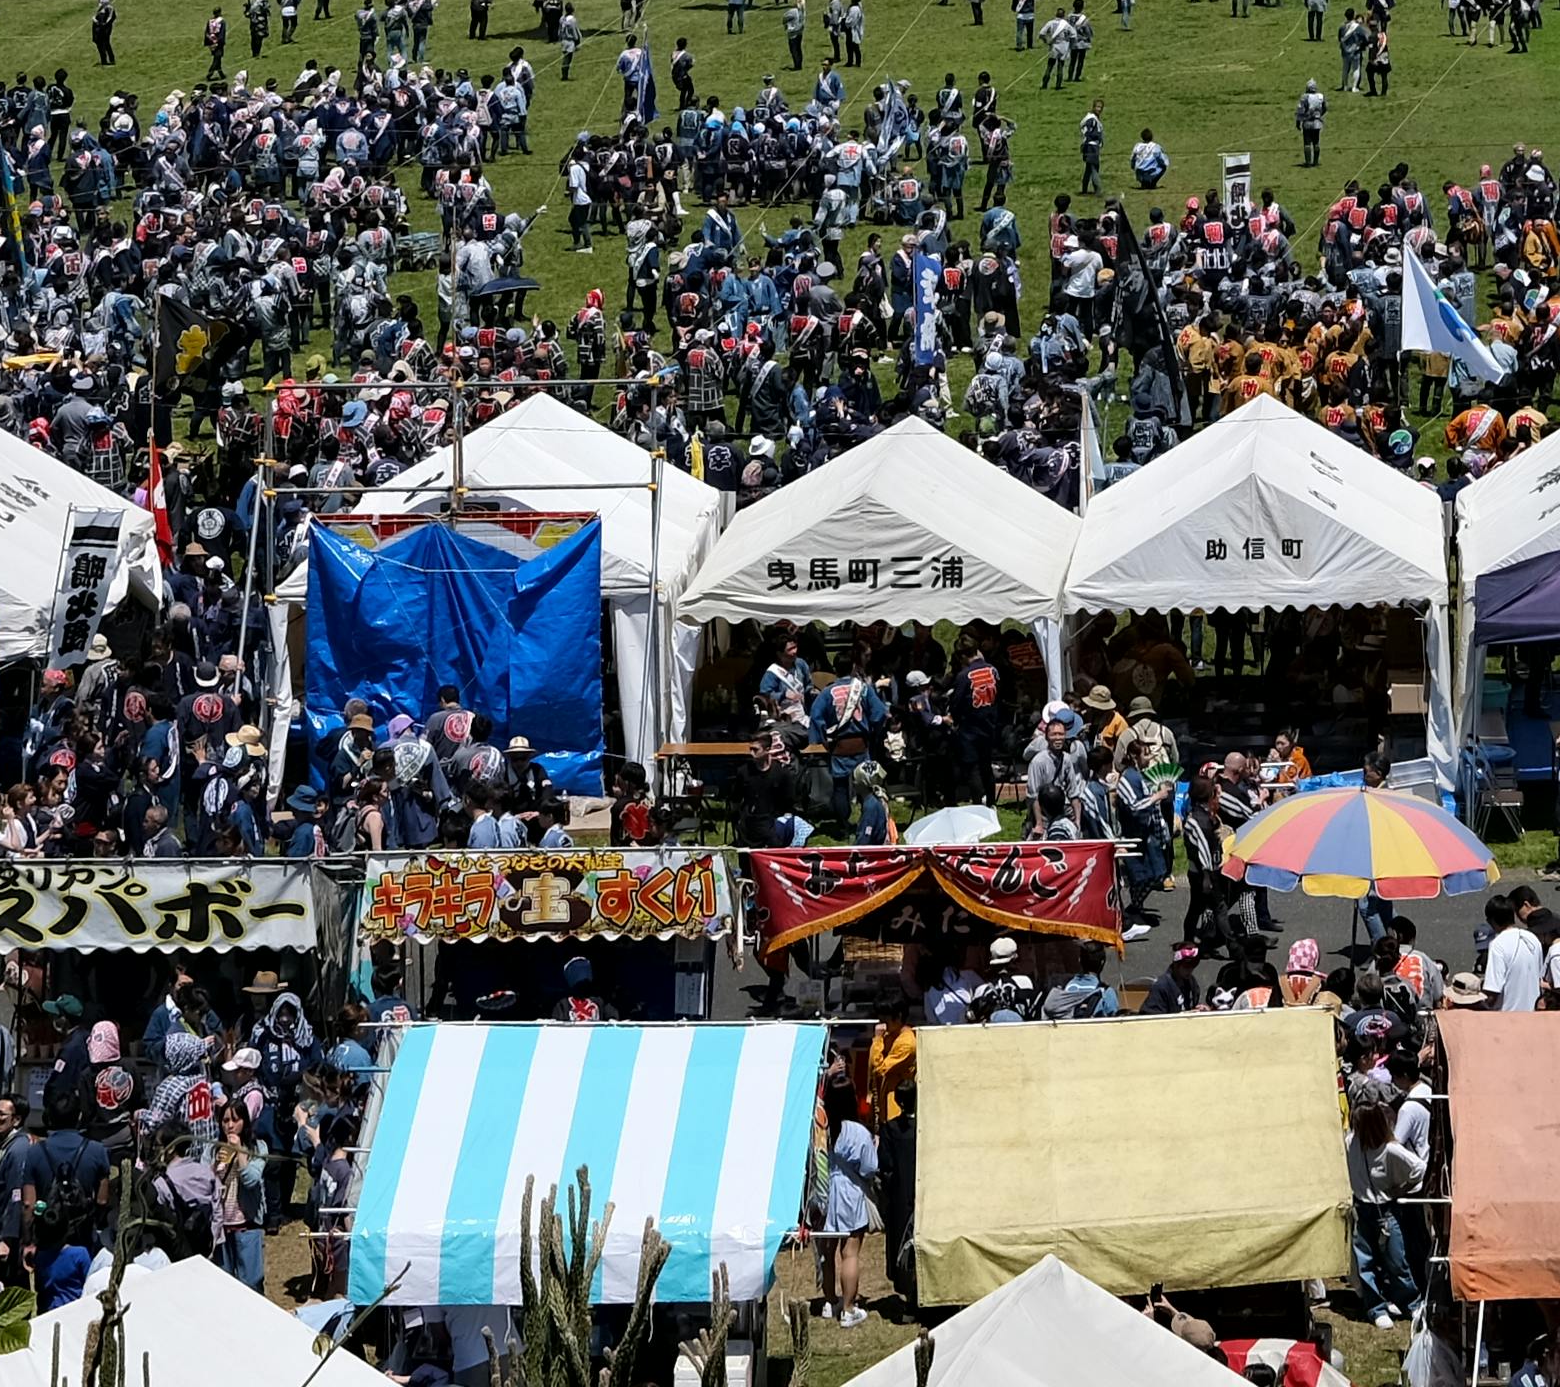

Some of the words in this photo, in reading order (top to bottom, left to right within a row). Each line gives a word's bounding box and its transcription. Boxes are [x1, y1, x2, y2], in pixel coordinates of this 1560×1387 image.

[1205, 536, 1305, 561] 助信町
[766, 555, 965, 592] 曳馬町三浦
[369, 872, 496, 929] キラキラ
[596, 861, 718, 927] すくい
